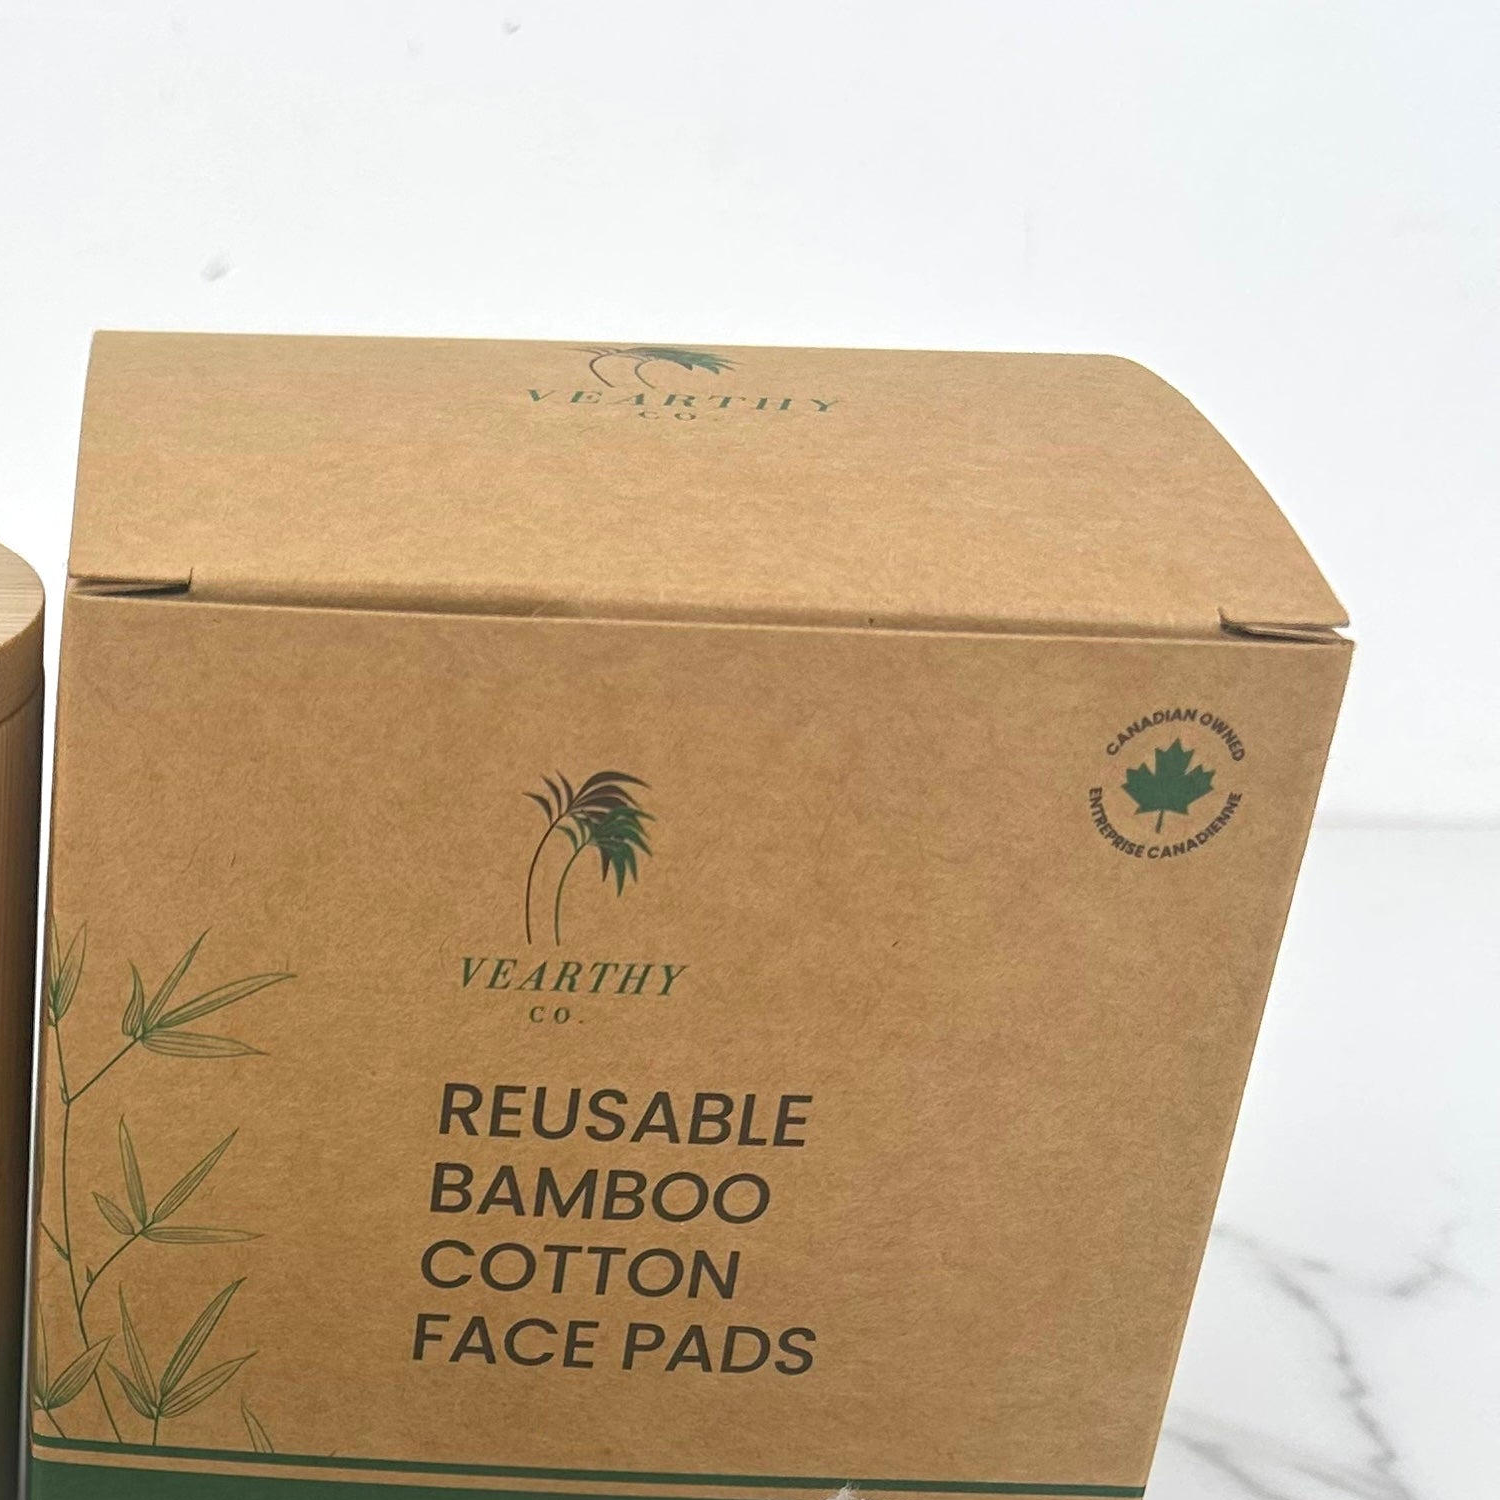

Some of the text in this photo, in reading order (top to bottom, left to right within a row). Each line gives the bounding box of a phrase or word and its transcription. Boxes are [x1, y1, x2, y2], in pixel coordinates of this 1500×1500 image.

[528, 388, 839, 412] VEARTHY
[1106, 708, 1245, 762] CANADIAN OWNED
[1089, 787, 1243, 860] ENTREPRISE CANADIENNE
[461, 956, 689, 997] VEARTHY
[529, 1006, 584, 1025] CO.
[438, 1082, 814, 1148] REUSABLE
[429, 1162, 771, 1225] BAMBOO
[420, 1239, 741, 1300] COTTON
[412, 1313, 817, 1376] FACE PADS
